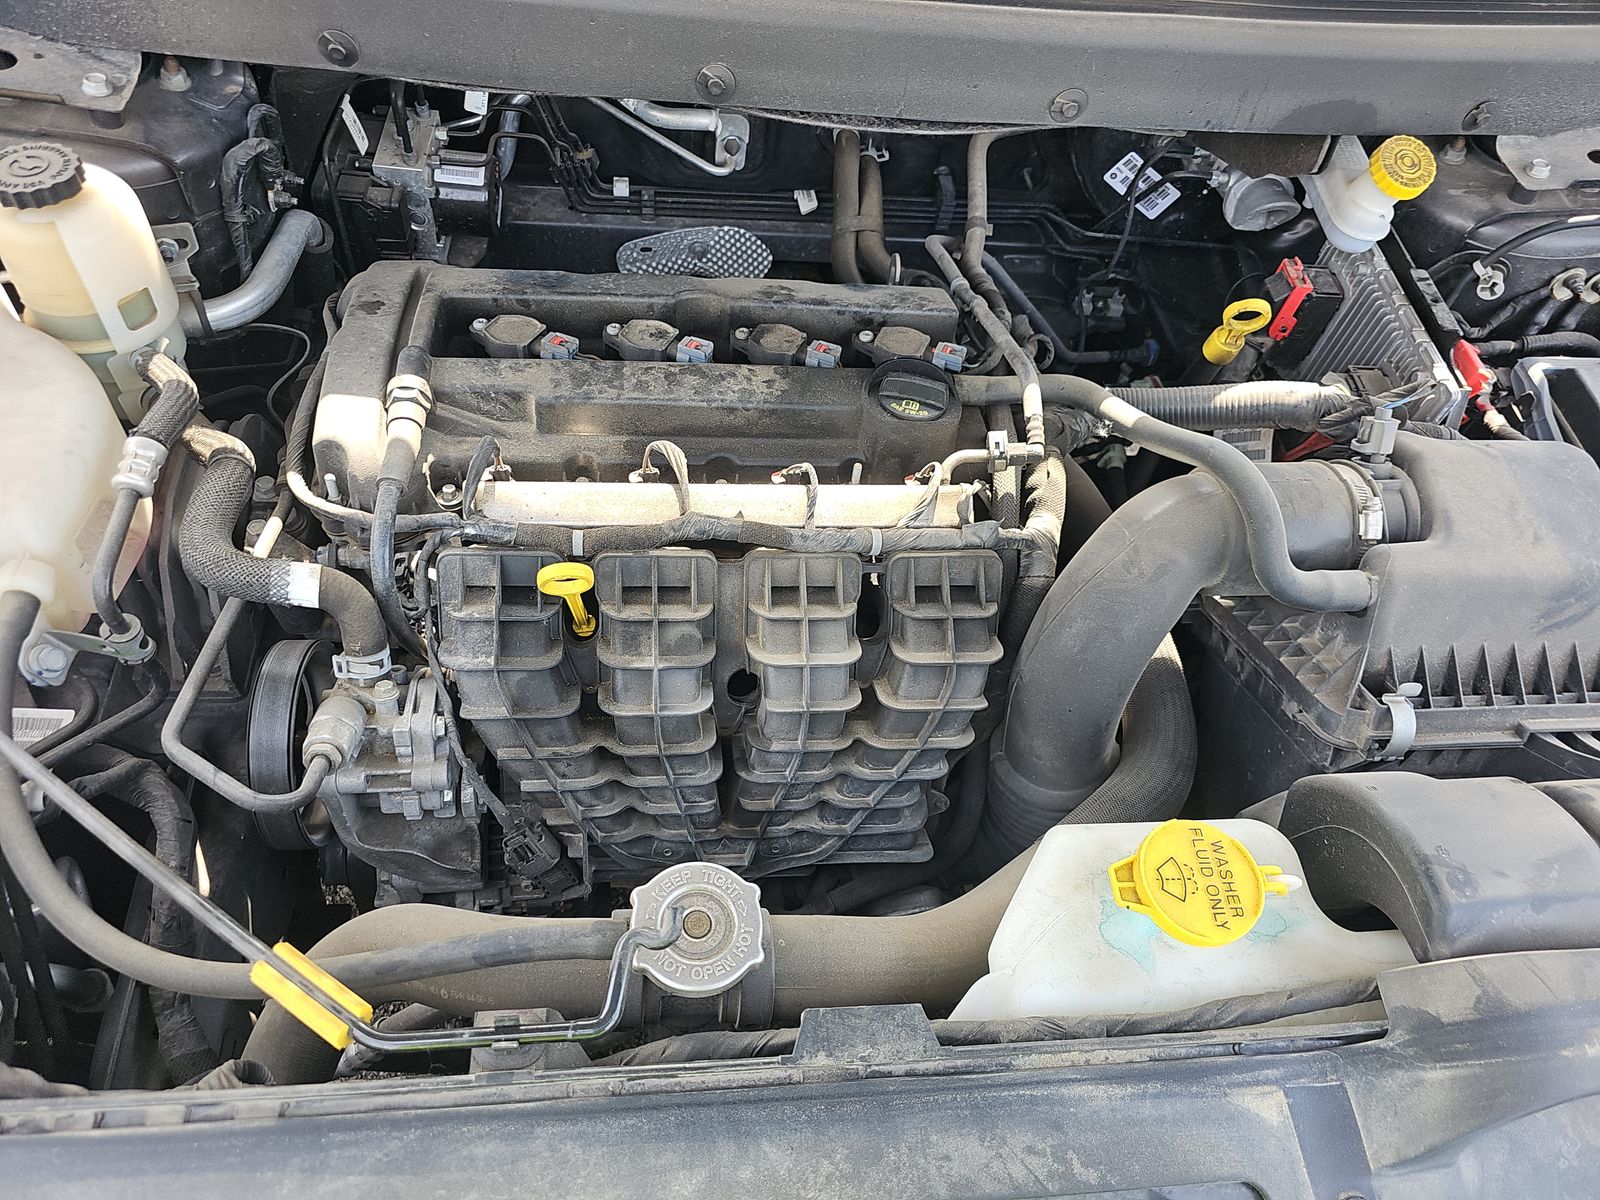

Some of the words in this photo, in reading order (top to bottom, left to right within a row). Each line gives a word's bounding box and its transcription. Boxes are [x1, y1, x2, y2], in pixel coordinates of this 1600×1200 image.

[652, 869, 693, 902] KEEP
[702, 869, 744, 898] TIGHT
[1188, 828, 1214, 878] FLUID
[1205, 884, 1232, 931] ONLY
[1210, 839, 1245, 918] WASHER
[655, 951, 687, 977] NOT
[690, 954, 736, 980] OPEN
[733, 923, 754, 958] HOT
